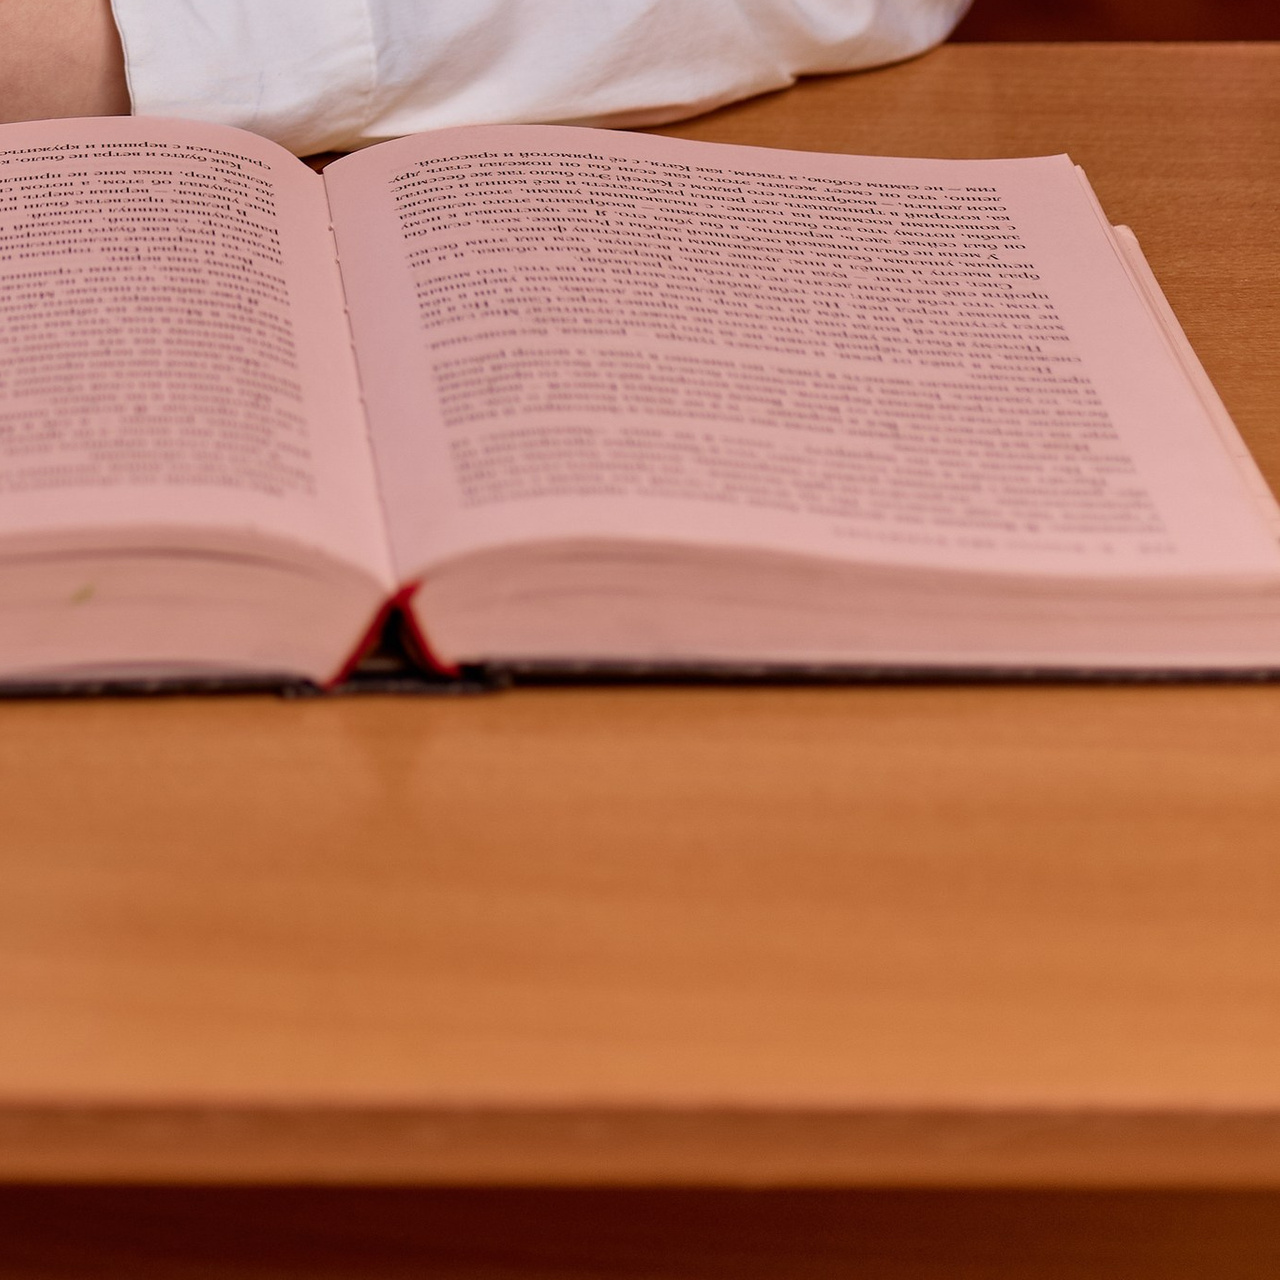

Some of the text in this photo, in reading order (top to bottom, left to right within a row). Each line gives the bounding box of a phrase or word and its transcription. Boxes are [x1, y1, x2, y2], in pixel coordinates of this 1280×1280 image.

[101, 140, 168, 150] вершин
[69, 153, 89, 161] не
[93, 150, 141, 159] ветра
[160, 152, 208, 165] будто
[186, 145, 272, 172] срываться
[519, 152, 605, 162] прямотой
[211, 157, 242, 172] Как
[479, 161, 552, 169] пожелал
[559, 161, 581, 169] он
[609, 156, 628, 166] её
[133, 169, 174, 177] пока
[426, 163, 473, 176] стать
[587, 163, 612, 174] бы
[618, 166, 657, 177] если
[695, 166, 724, 175] как
[68, 171, 88, 179] не
[470, 171, 493, 179] же
[529, 170, 575, 180] было
[578, 171, 612, 183] Это
[663, 171, 692, 181] как
[20, 181, 74, 192] потом
[151, 179, 173, 188] об
[223, 177, 251, 191] тех
[475, 179, 528, 188] копил
[533, 179, 561, 188] всё
[616, 175, 674, 190] Катей!
[756, 181, 818, 193] желать
[866, 182, 920, 192] самим
[89, 186, 150, 196] верная
[179, 180, 249, 199] подумал
[255, 186, 275, 199] до
[395, 184, 454, 202] считал
[464, 189, 513, 199] этого
[581, 181, 685, 198] разбогатеть
[690, 183, 743, 195] рядом
[747, 189, 776, 198] его
[824, 187, 873, 198] смеет
[924, 185, 944, 193] не
[23, 190, 85, 202] смерть
[75, 195, 165, 206] просветах
[255, 195, 276, 208] но
[589, 190, 698, 208] пылающими
[690, 192, 747, 205] решил
[778, 192, 878, 207] вообразить
[879, 192, 901, 200] он
[907, 194, 938, 202] что
[24, 200, 70, 211] были
[170, 198, 231, 213] редких
[482, 198, 531, 207] этого
[535, 197, 637, 210] вообразить
[751, 199, 780, 208] лет
[244, 201, 277, 218] ные
[399, 201, 477, 221] человека
[464, 205, 561, 218] чувствовал
[784, 202, 886, 217] тринадцать
[966, 205, 1008, 213] свои
[653, 215, 694, 227] убил
[659, 206, 768, 225] невозможно
[791, 211, 812, 220] на
[819, 214, 894, 227] космами
[904, 211, 982, 222] который
[401, 215, 442, 231] нему
[700, 221, 724, 232] бы
[772, 219, 819, 232] было
[822, 224, 853, 233] это
[900, 221, 1001, 232] кошачьими
[857, 227, 888, 236] что
[893, 228, 956, 240] потому
[898, 239, 957, 250] сейчас
[963, 243, 999, 252] был
